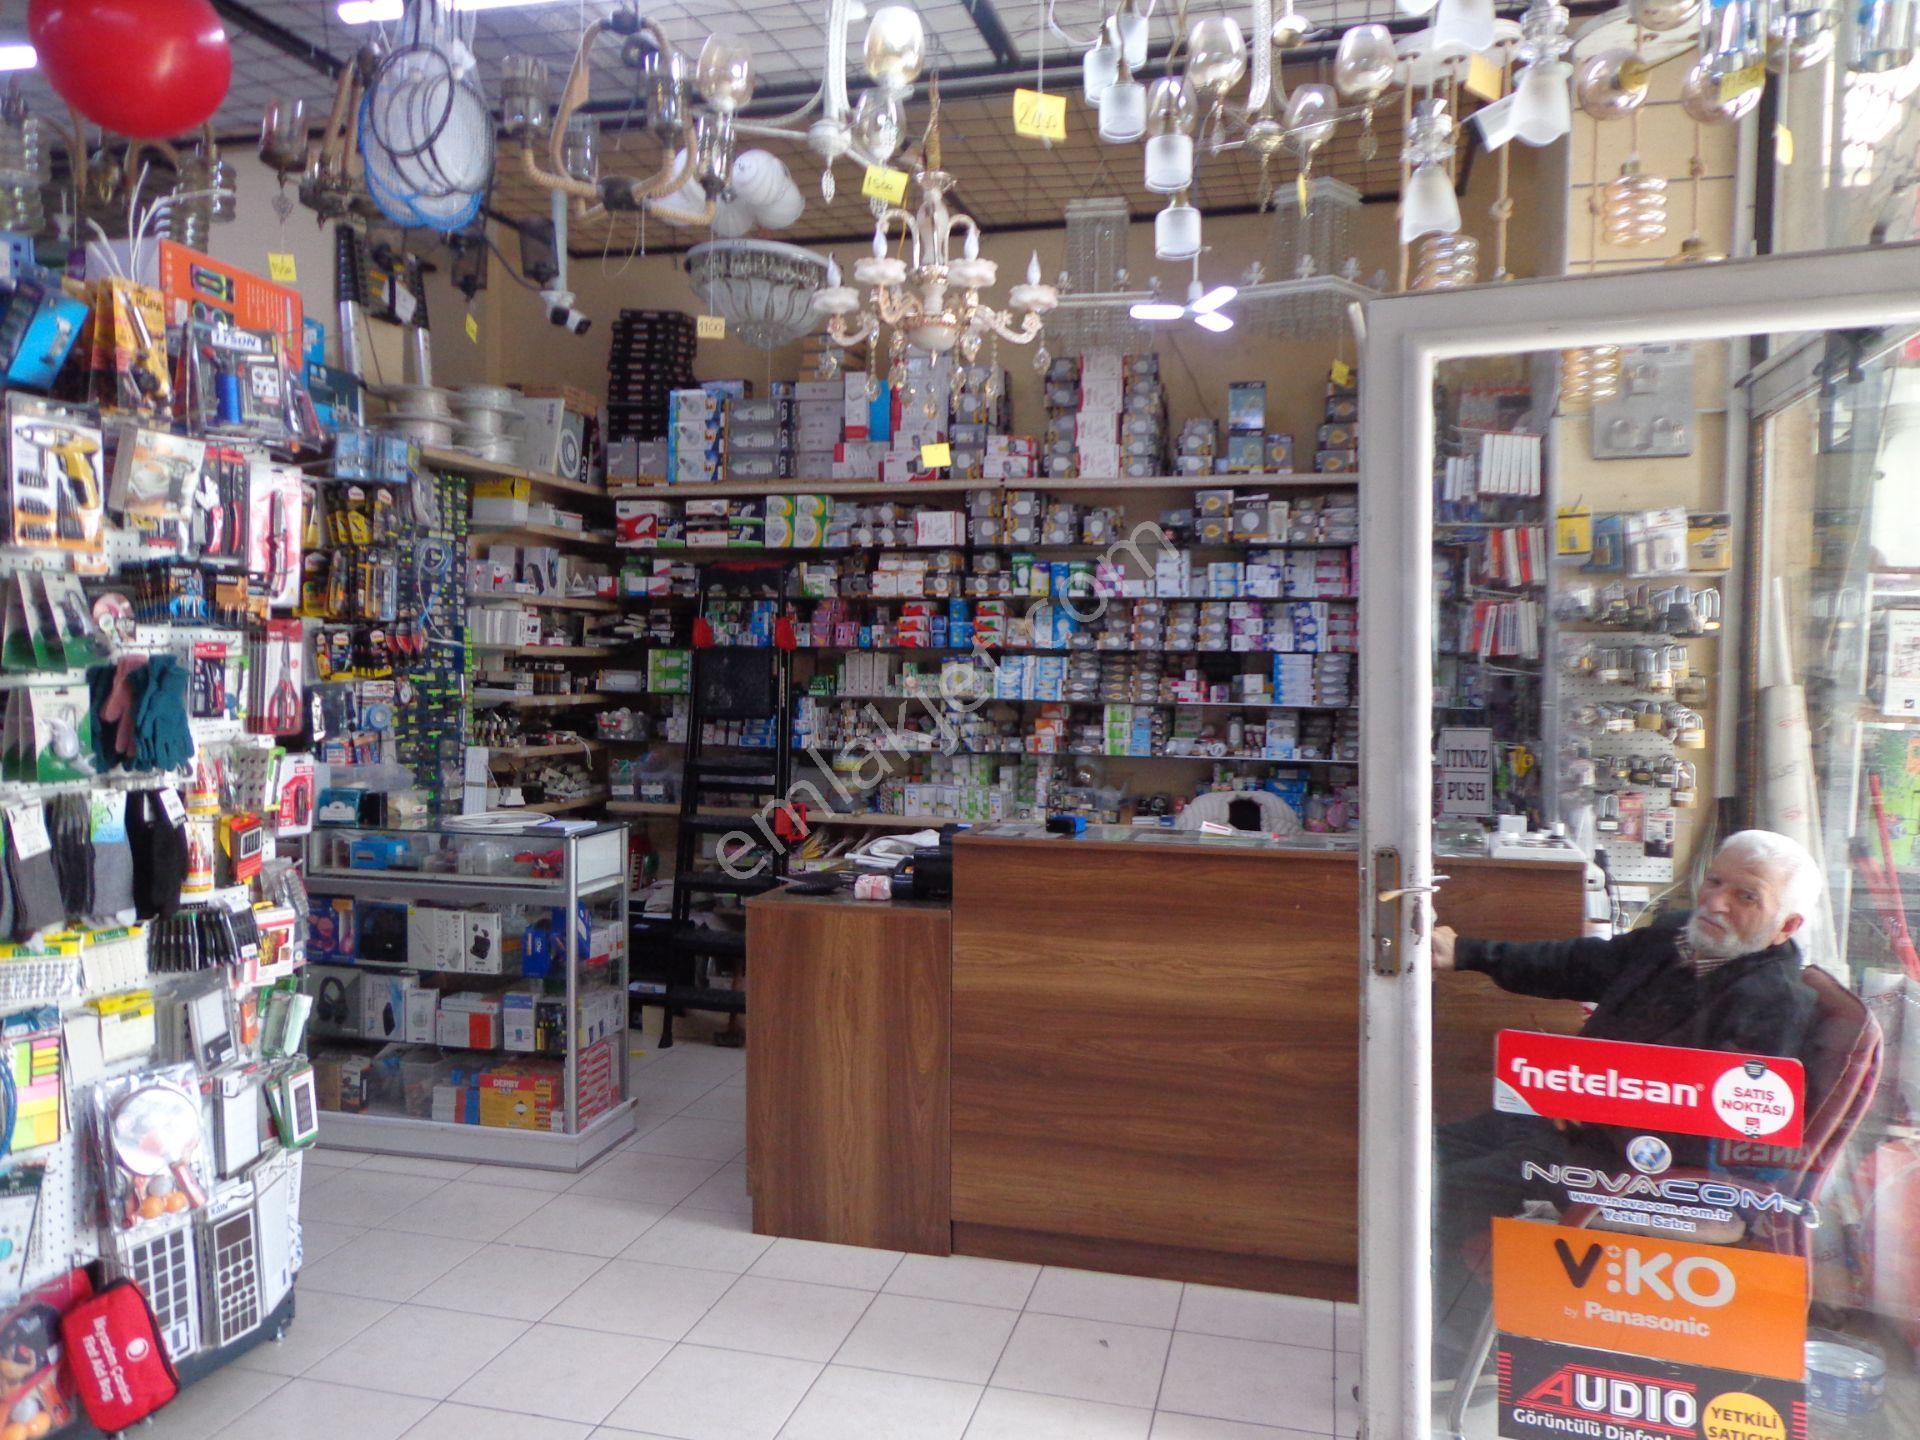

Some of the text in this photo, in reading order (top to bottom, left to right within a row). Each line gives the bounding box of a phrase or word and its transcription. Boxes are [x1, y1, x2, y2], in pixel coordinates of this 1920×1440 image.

[1447, 782, 1485, 800] PUSH
[1734, 1086, 1775, 1103] SATIŞ
[1721, 1098, 1786, 1117] NOKTASI
[1521, 1160, 1788, 1213] NOVACOM
[1567, 1190, 1732, 1222] www.novacom.com.tr
[1603, 1208, 1650, 1226] Yetkili
[1563, 1300, 1711, 1338] by Panasonic
[1520, 1367, 1698, 1428] AUDIO
[1513, 1408, 1672, 1440] Görüntülü Diaf
[1711, 1406, 1778, 1430] YETKİLİ
[1708, 1426, 1782, 1440] SATIC
